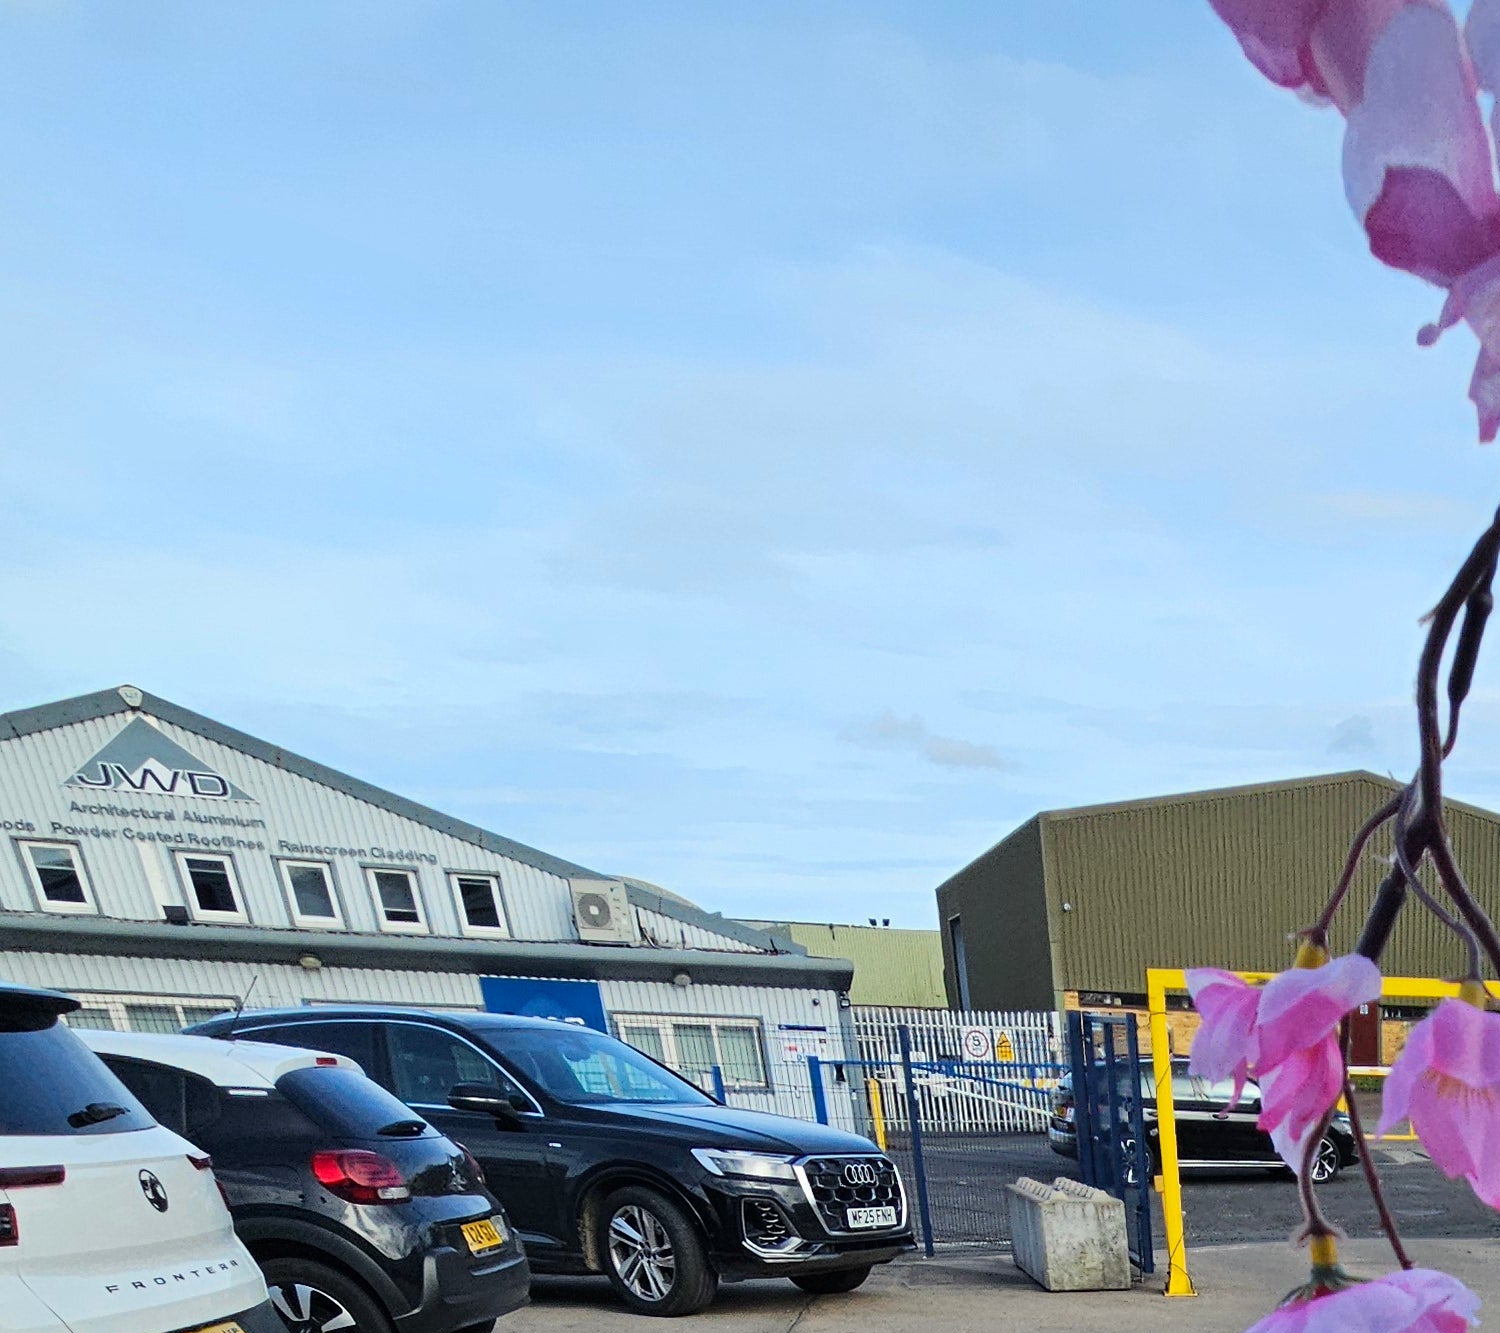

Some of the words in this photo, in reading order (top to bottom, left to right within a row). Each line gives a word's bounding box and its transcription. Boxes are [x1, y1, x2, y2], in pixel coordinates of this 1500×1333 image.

[75, 762, 229, 797] JWD
[0, 819, 35, 831] ods
[70, 801, 175, 821] Architectural
[181, 810, 266, 829] Aluminium
[51, 821, 118, 839] Powder
[122, 827, 184, 844] Coated
[187, 833, 265, 850] Rooflines
[278, 839, 367, 857] Rainscreen
[370, 846, 438, 865] Cladding
[972, 1035, 981, 1047] 5
[105, 1259, 239, 1294] FRONTERA
